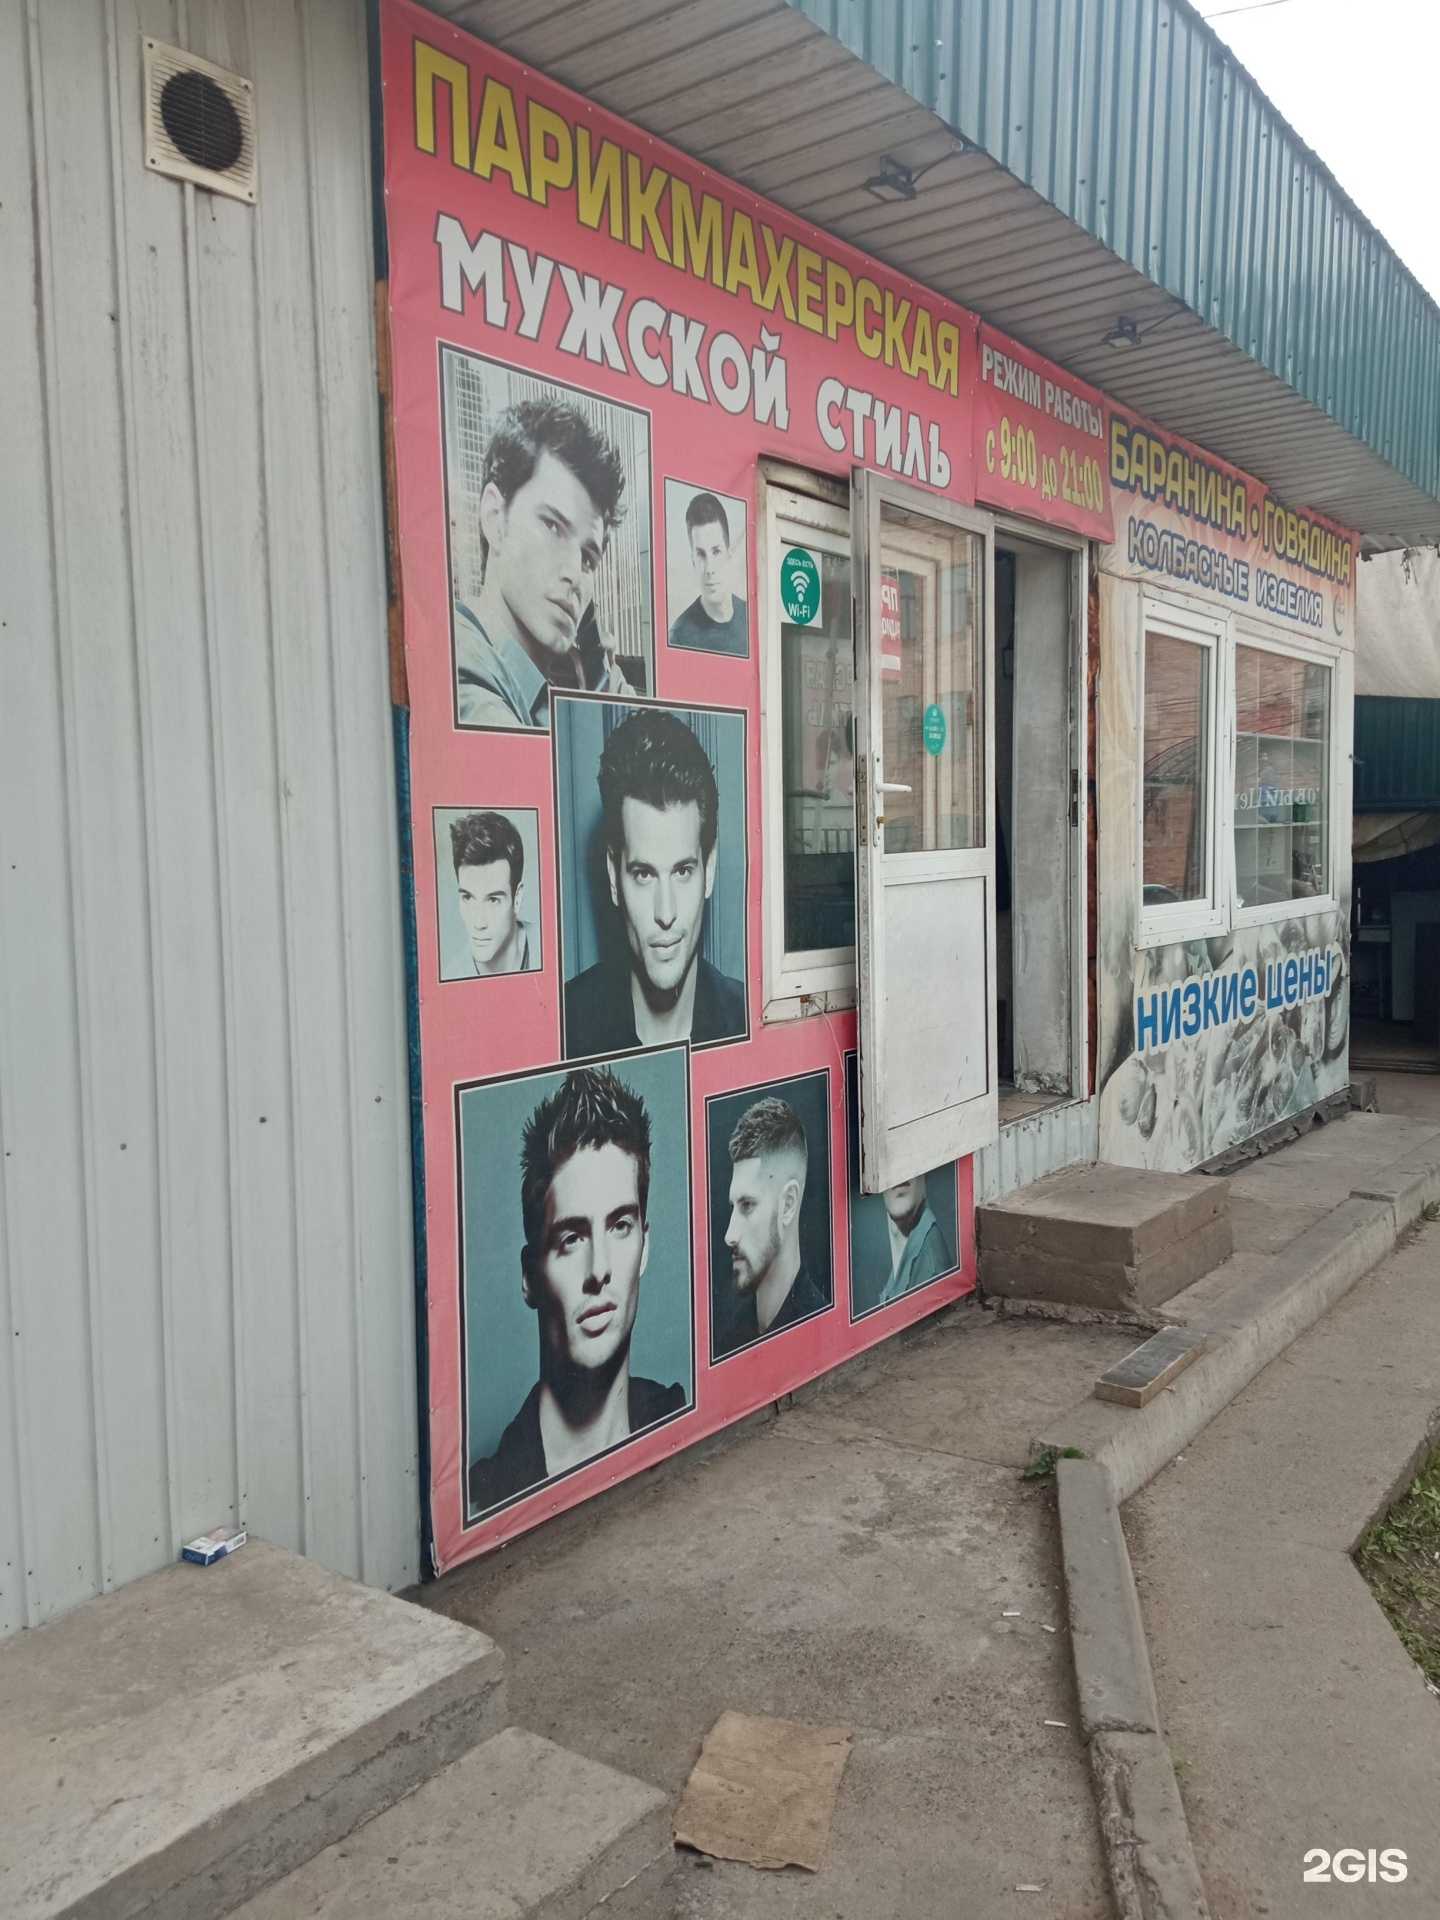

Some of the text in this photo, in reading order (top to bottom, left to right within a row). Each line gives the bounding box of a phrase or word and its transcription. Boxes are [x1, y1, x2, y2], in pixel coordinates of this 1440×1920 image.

[413, 38, 960, 397] ПАРИКМАХЕРСКАЯ
[434, 212, 952, 489] МУЖСКОЙ СТИЛЬ
[982, 343, 1104, 439] РЕЖИМ РАБОТЫ
[1000, 416, 1037, 489] 9:00
[1041, 453, 1058, 502] до
[1060, 445, 1105, 513] 21:00
[1110, 414, 1352, 587] БАРАНИНА ГОВЯДИНА
[788, 602, 811, 618] Wi-Fi
[1128, 517, 1324, 628] КОЛБАСНЫЕ ИЗДЕЛИЯ
[1266, 950, 1333, 1010] цены
